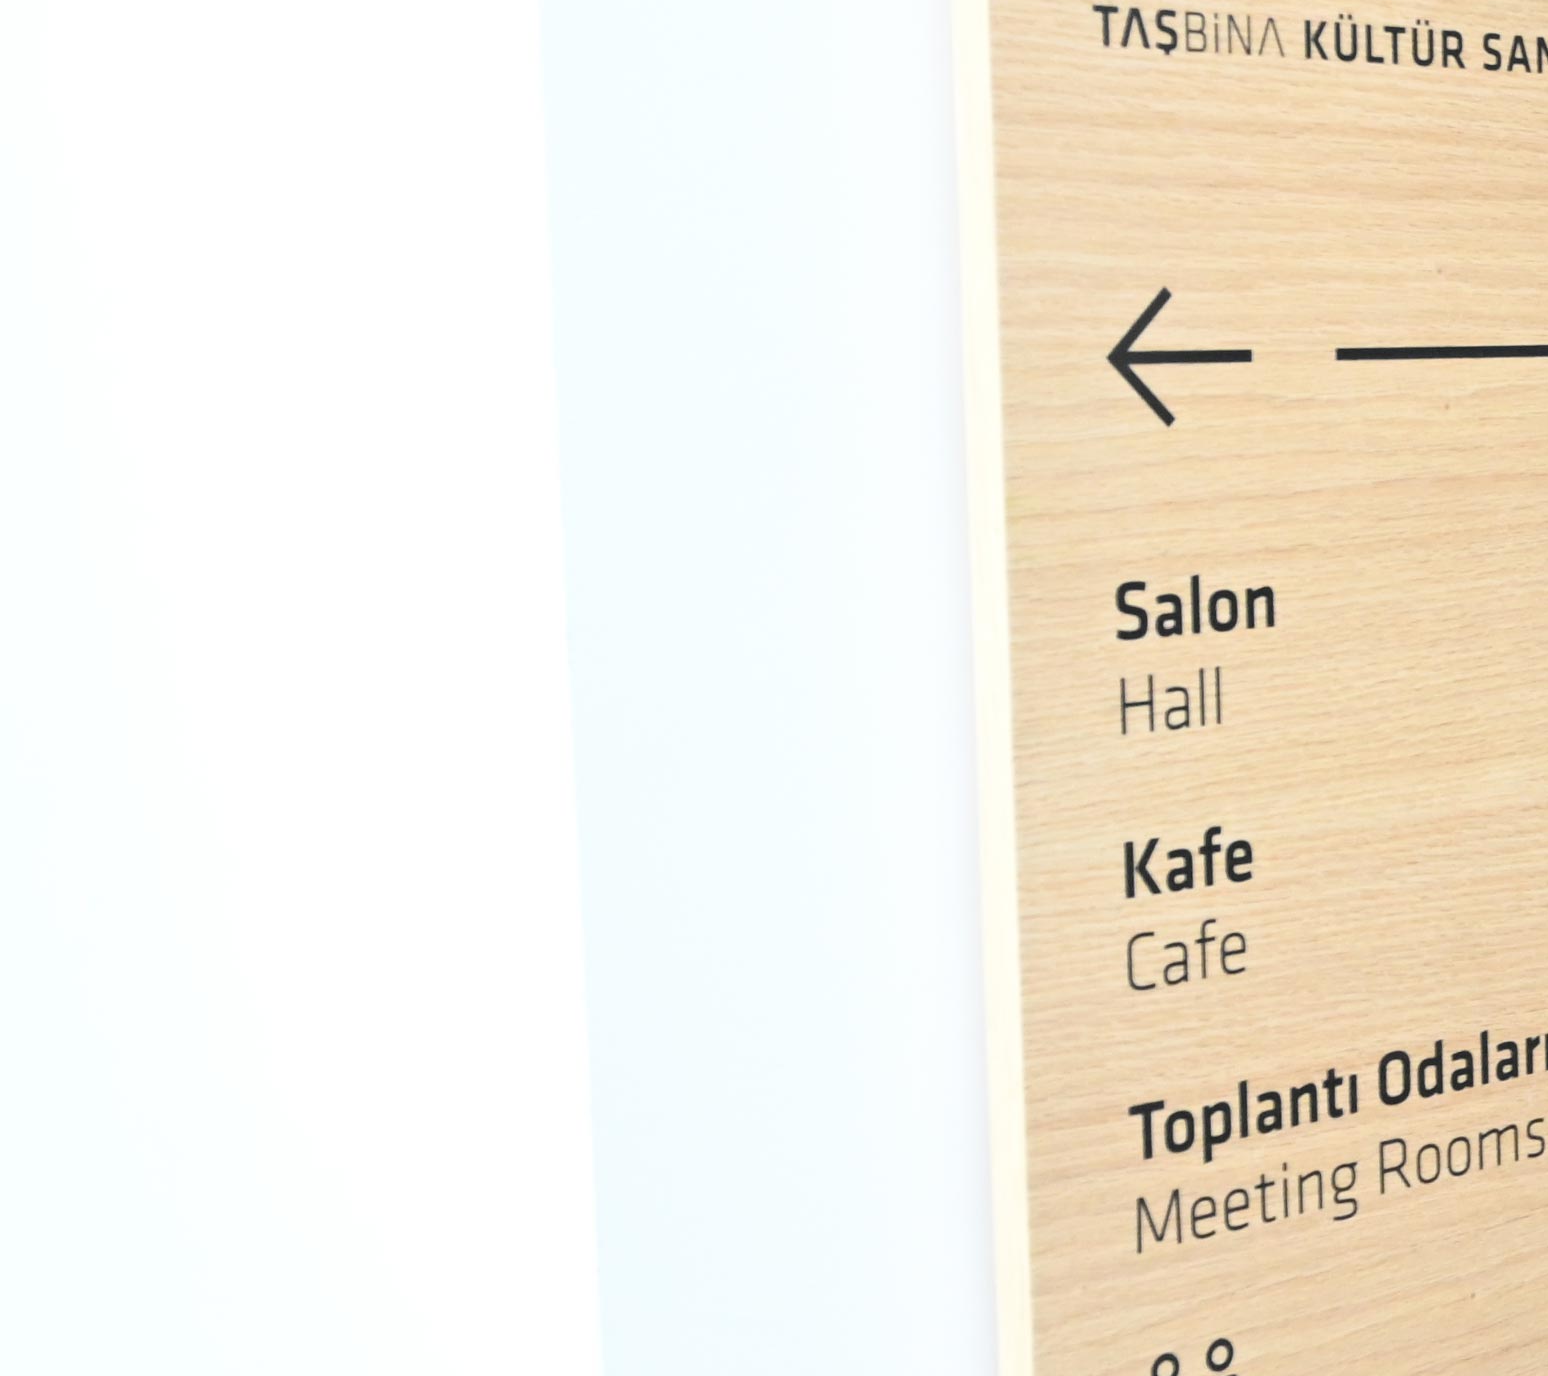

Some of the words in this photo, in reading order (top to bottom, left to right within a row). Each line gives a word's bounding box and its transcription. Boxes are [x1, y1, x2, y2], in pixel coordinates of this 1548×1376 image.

[1304, 13, 1466, 70] KÜLTÜR
[1115, 574, 1276, 641] Salon
[1119, 666, 1222, 735] Hall
[1123, 825, 1254, 899] Kafe
[1126, 918, 1247, 991] Cafe
[1129, 1068, 1359, 1164] Toplantı
[1136, 1161, 1359, 1254] Meeting
[1378, 1116, 1547, 1194] Rooms
